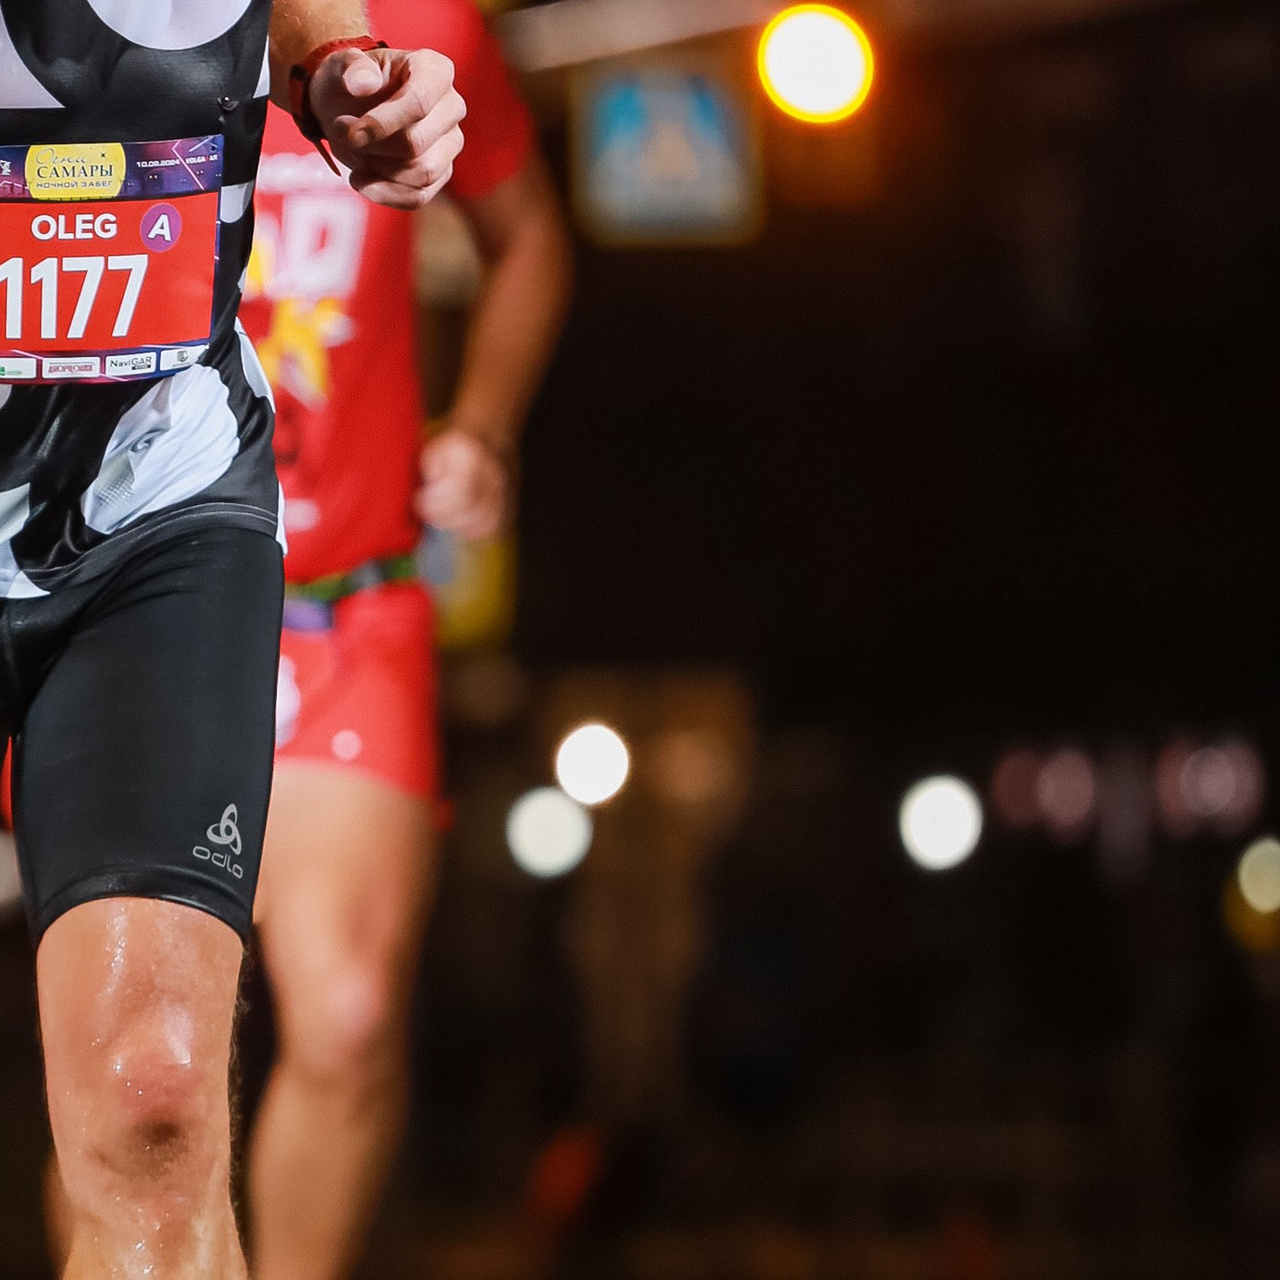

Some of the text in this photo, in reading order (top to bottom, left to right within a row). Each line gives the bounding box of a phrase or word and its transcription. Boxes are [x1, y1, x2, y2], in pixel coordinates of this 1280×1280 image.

[36, 164, 113, 179] САМАРЫ
[36, 180, 113, 189] НОЧНОЙ ЗАБЕГ
[31, 213, 118, 240] OLEG
[148, 214, 172, 241] A
[192, 845, 244, 879] odlo
